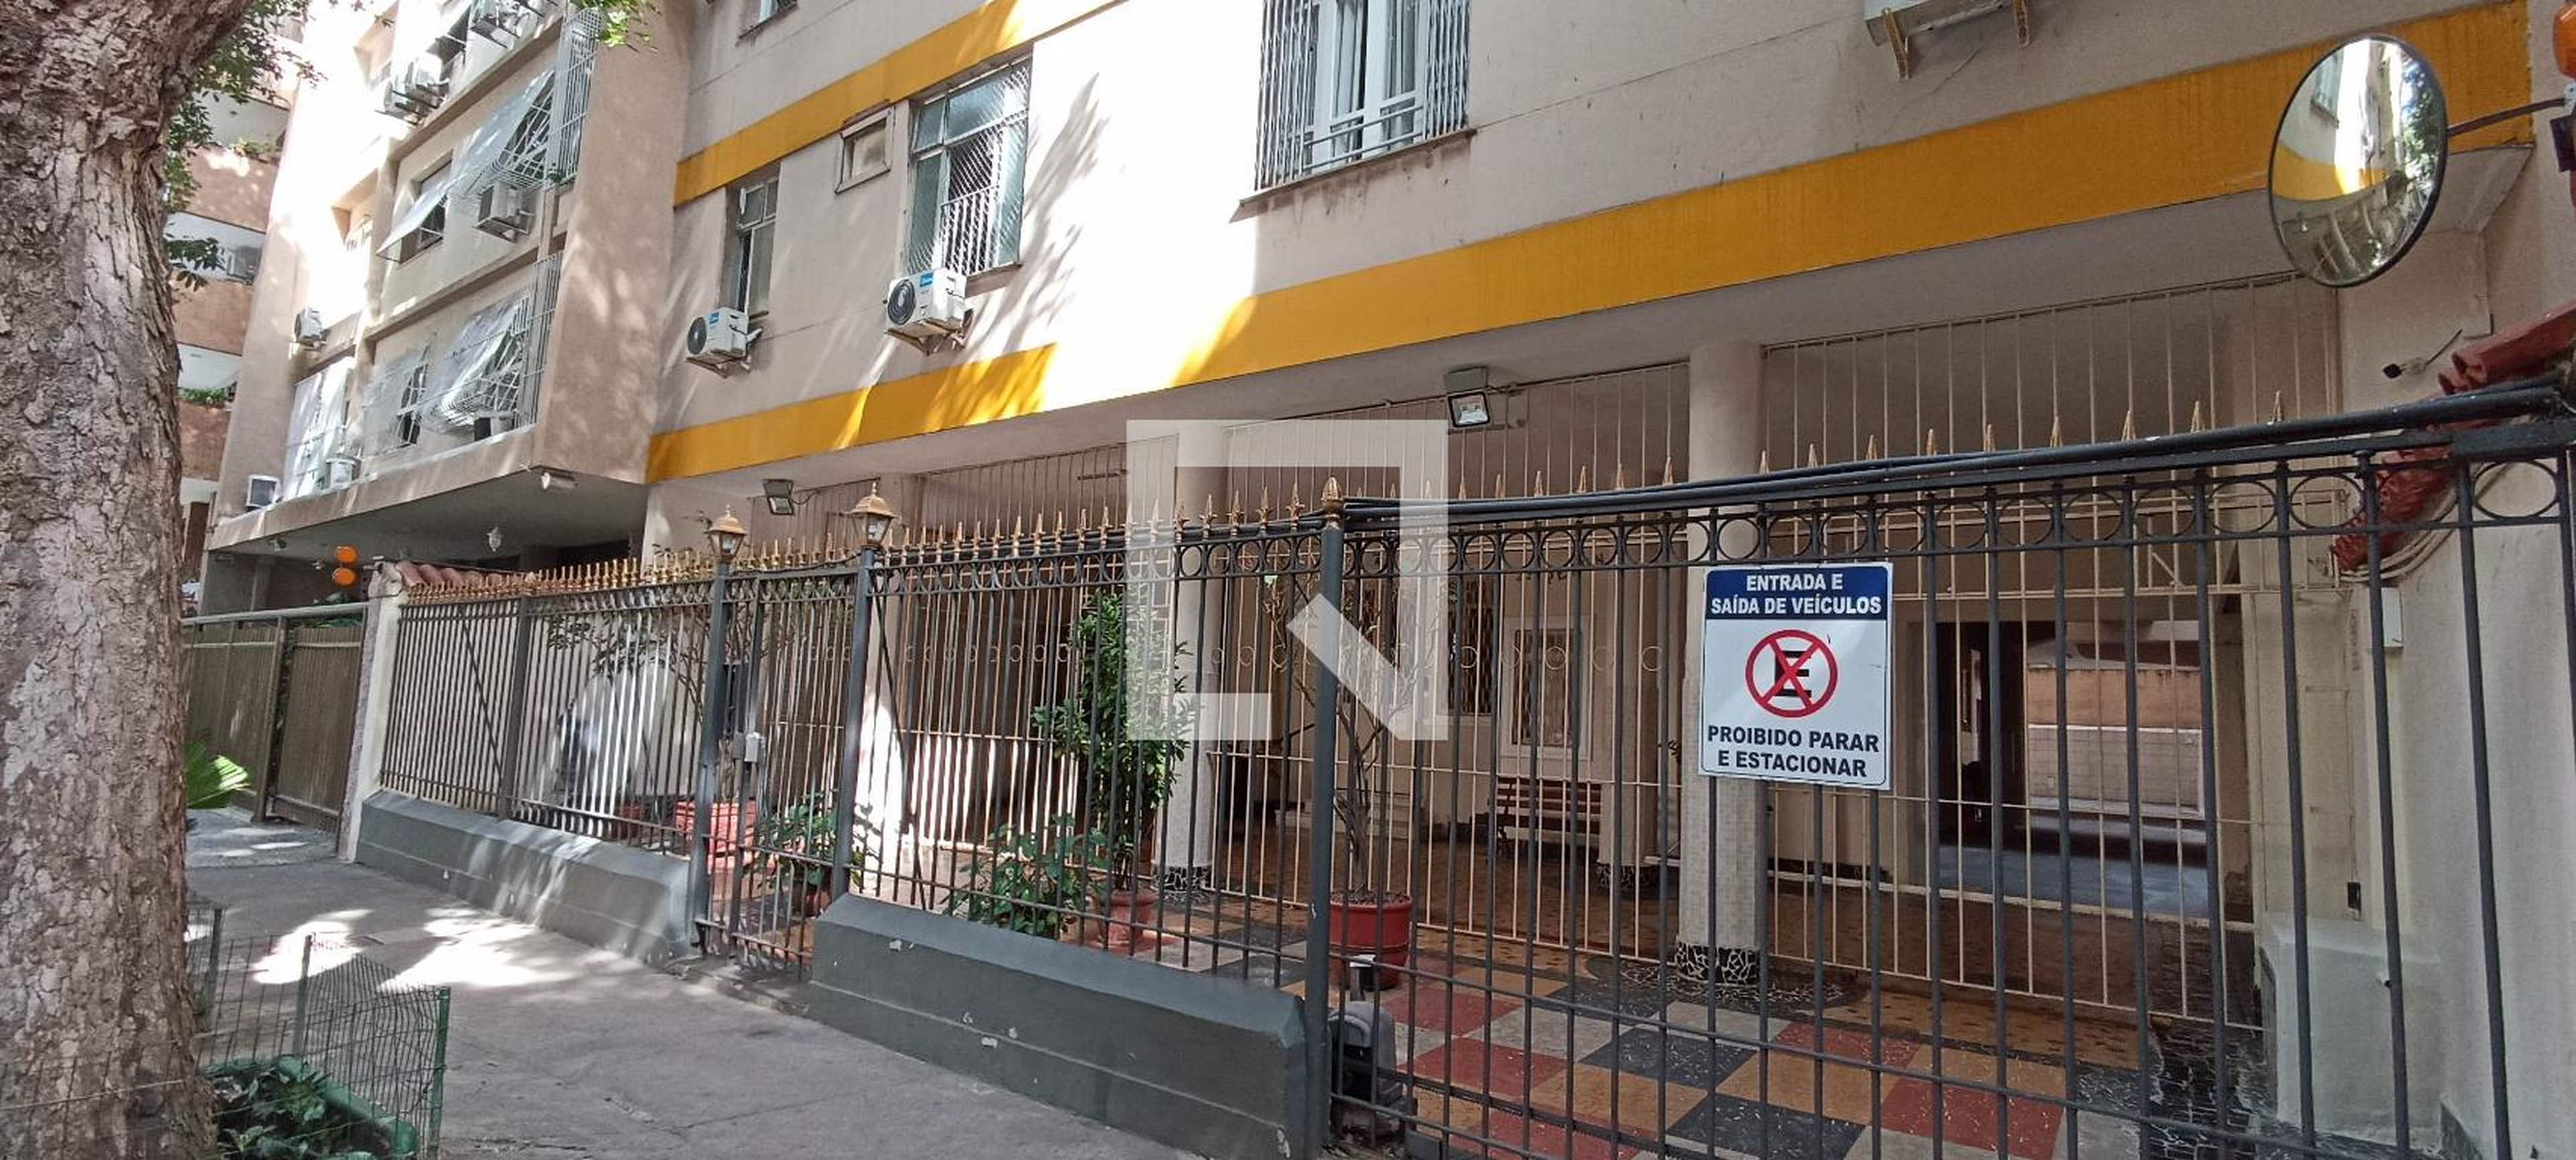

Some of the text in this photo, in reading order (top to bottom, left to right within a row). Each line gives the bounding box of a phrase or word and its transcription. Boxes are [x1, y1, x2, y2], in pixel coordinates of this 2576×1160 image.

[1746, 574, 1843, 590] ENTRADA E
[1711, 594, 1882, 614] SAÍDA DE VEÍCULOS
[1708, 725, 1879, 752] PROIBIDO PARAR
[1719, 751, 1866, 777] E ESTACIONAR
